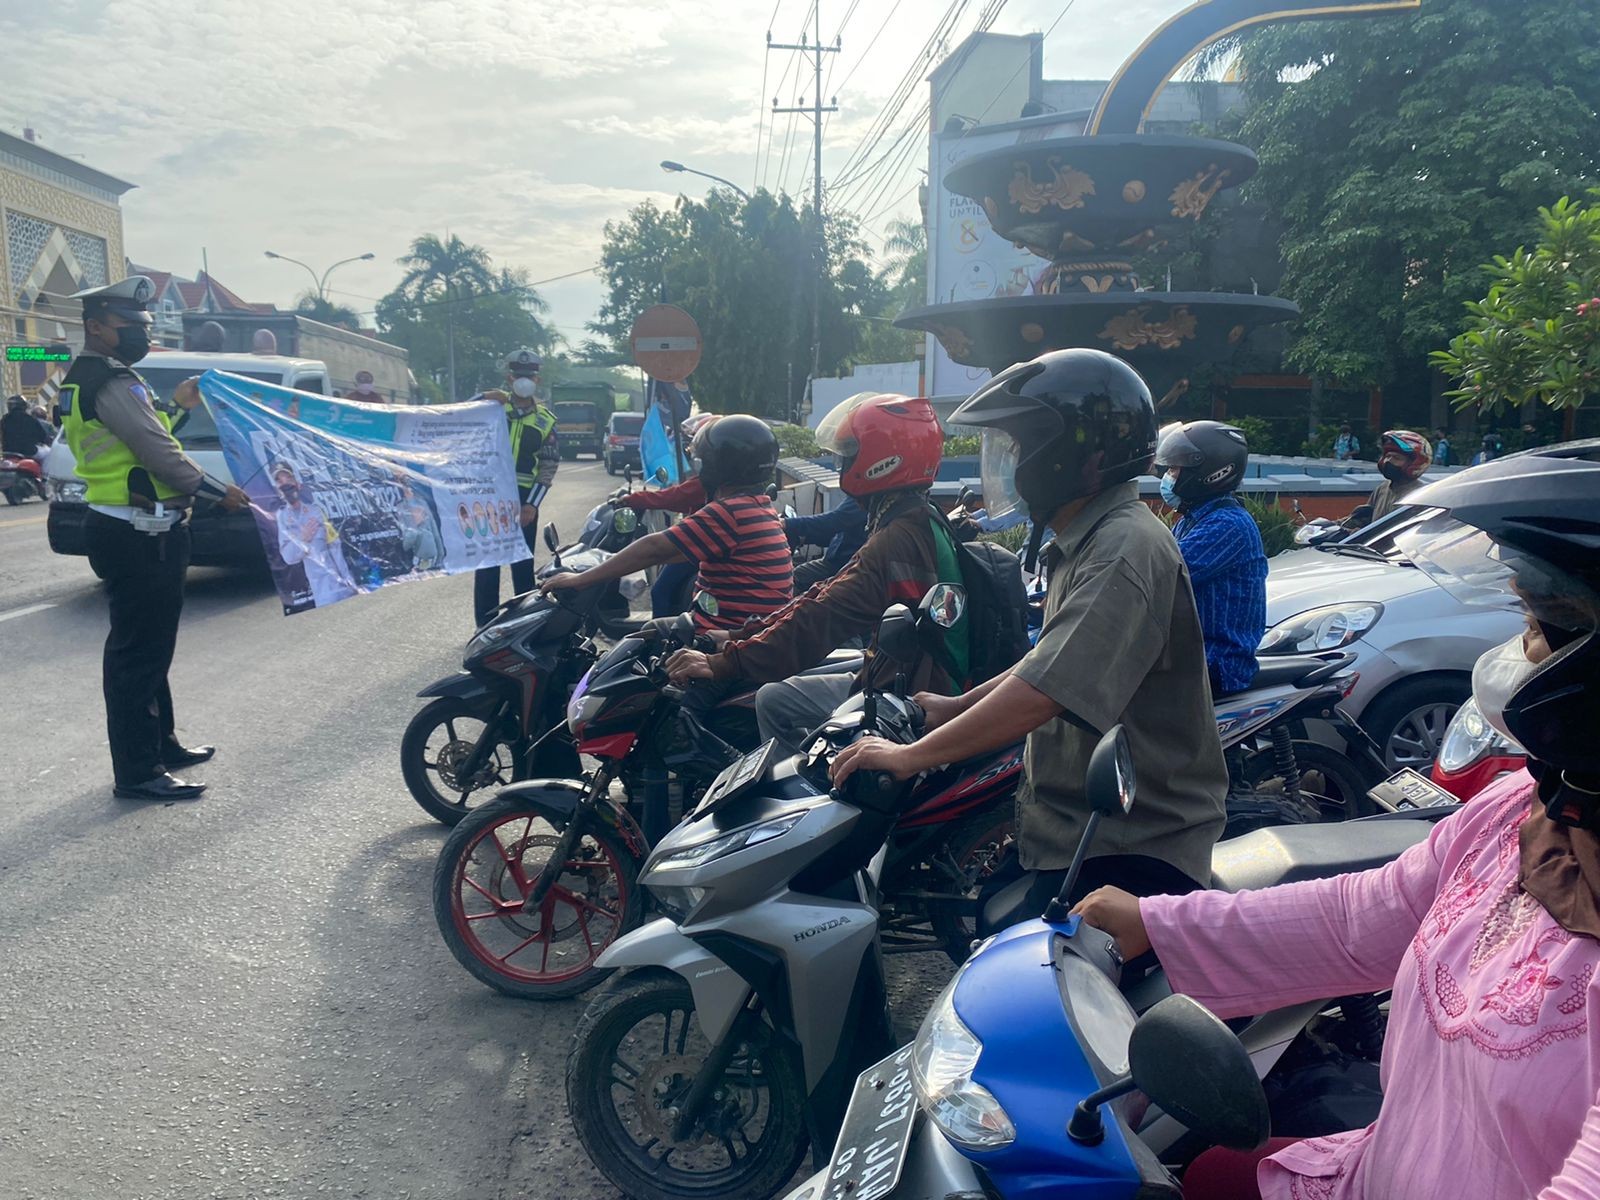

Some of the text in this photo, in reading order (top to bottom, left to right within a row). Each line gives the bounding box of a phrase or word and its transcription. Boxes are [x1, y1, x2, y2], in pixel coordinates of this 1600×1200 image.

[950, 197, 974, 207] FLA
[866, 455, 902, 478] INK
[793, 916, 851, 942] HONDA
